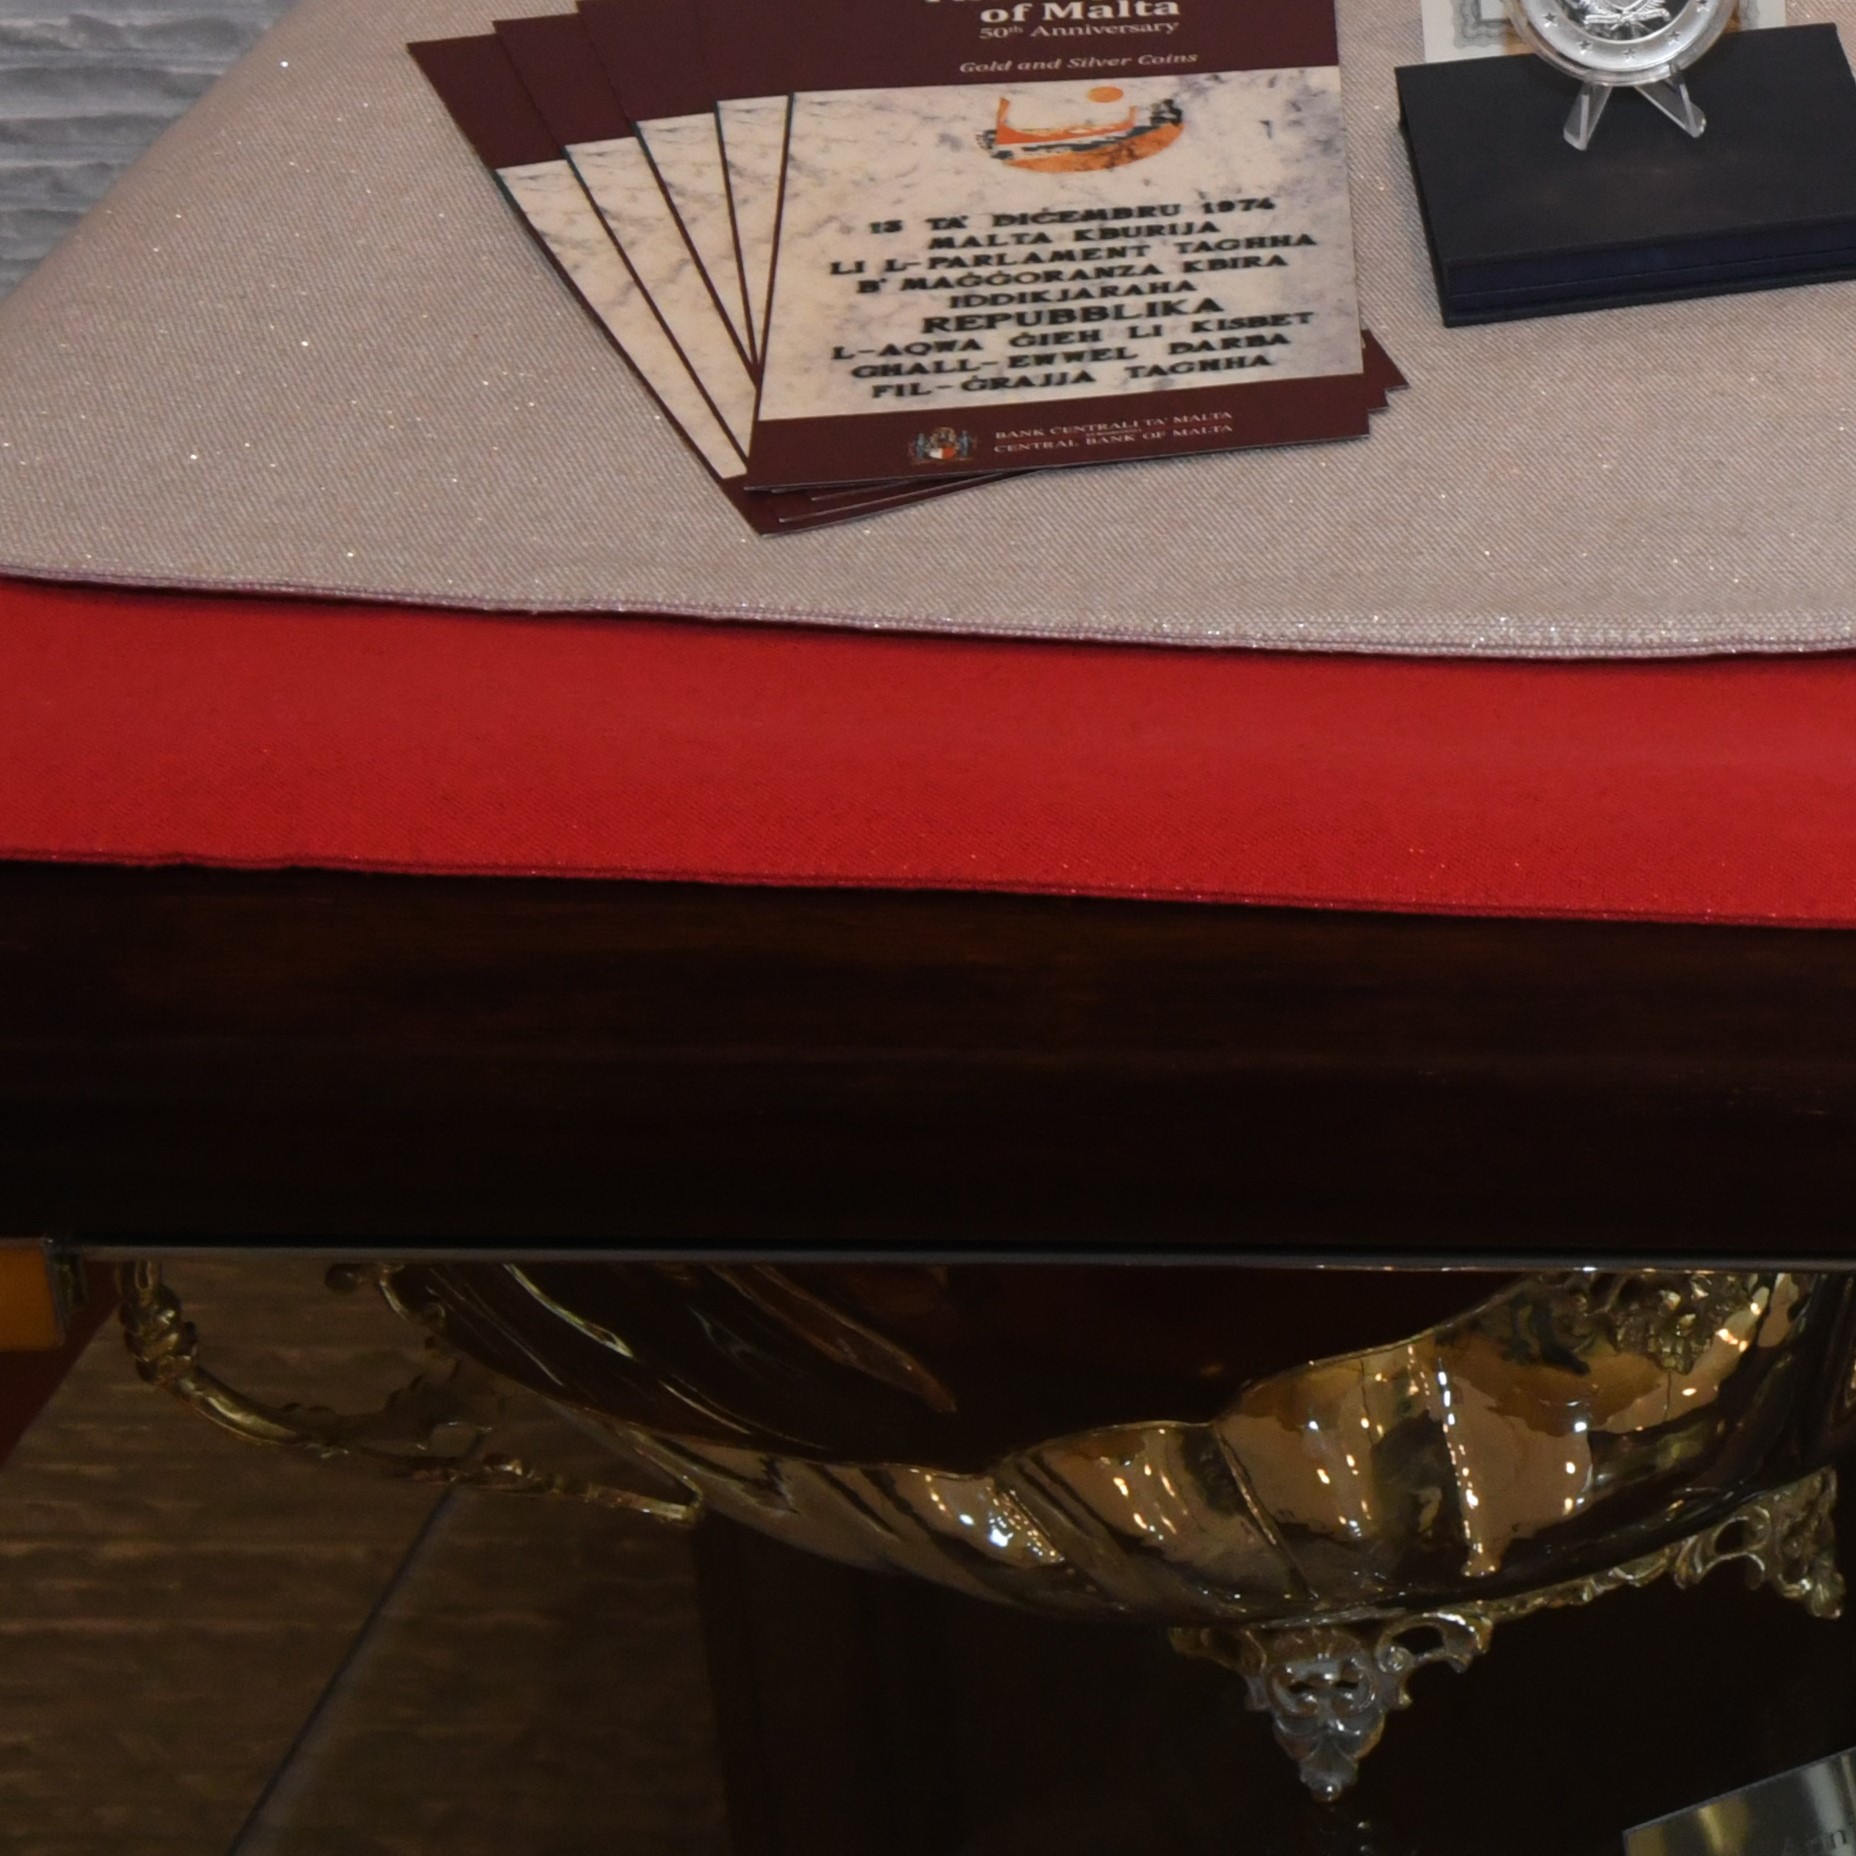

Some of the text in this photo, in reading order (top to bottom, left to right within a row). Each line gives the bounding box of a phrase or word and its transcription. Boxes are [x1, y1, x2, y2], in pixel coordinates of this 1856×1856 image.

[980, 0, 1180, 23] of Malta
[1031, 22, 1179, 38] Anniversary
[960, 52, 1198, 73] Gold and Silver Coins
[1202, 198, 1276, 214] 1974
[928, 232, 1053, 250] MALTA
[949, 280, 1197, 308] IDDIKJARAHA
[921, 298, 1224, 334] REPUBBLIKA
[996, 429, 1044, 439] BANK
[1174, 411, 1233, 424] MALTA
[994, 440, 1079, 452] CENTRAL
[1087, 435, 1135, 445] BANK
[1142, 431, 1166, 441] OF
[1172, 424, 1233, 437] MALTA
